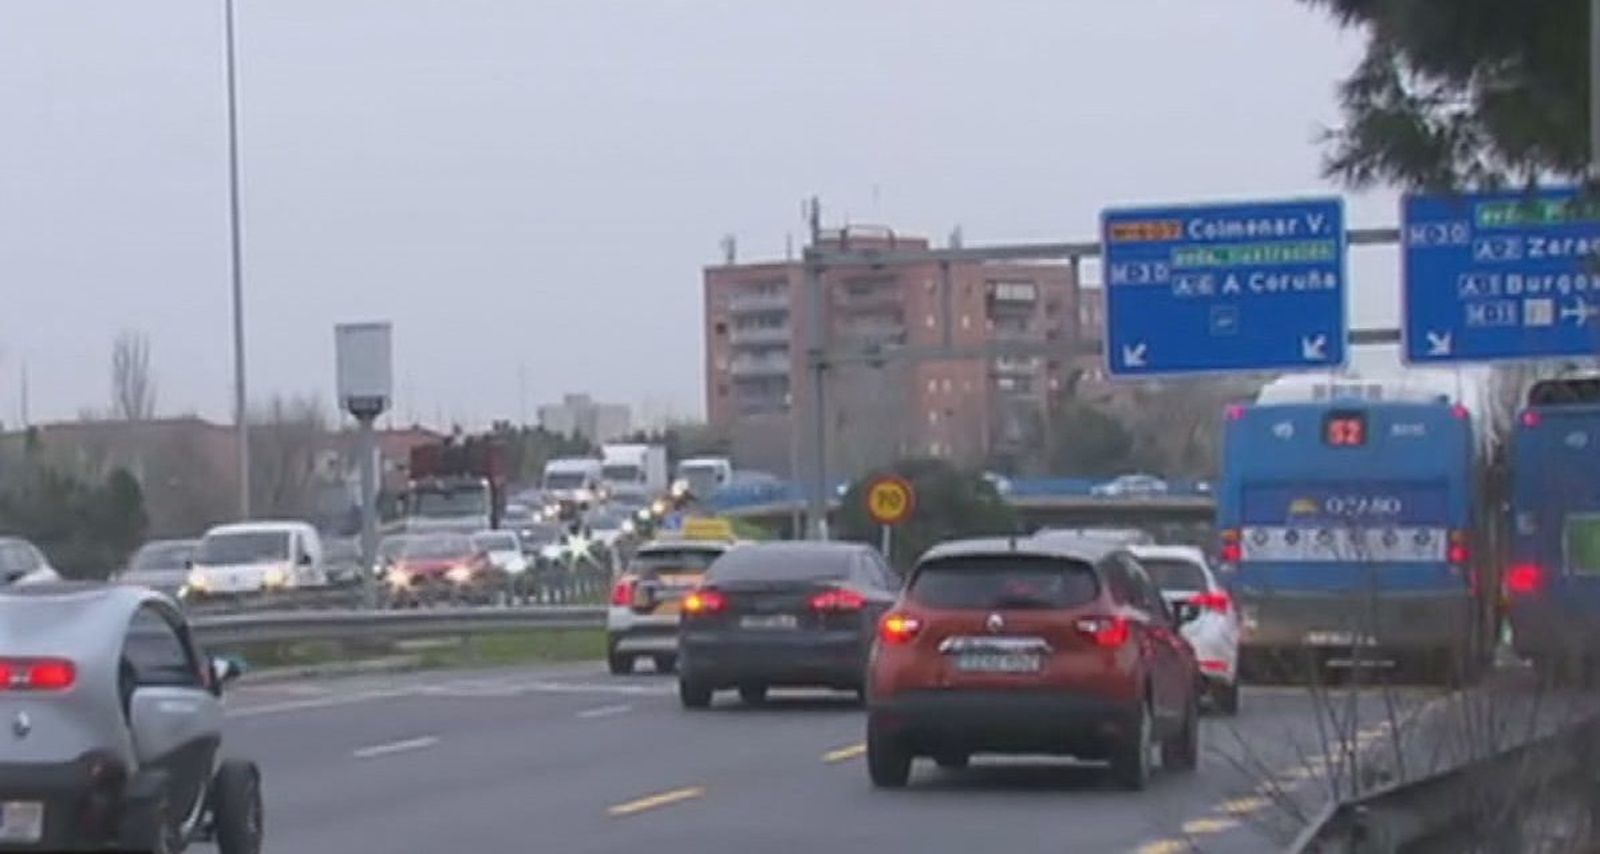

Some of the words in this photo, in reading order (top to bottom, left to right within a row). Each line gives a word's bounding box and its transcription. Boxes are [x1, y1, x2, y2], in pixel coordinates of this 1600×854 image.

[1187, 217, 1298, 239] Colmenar
[1306, 213, 1332, 234] V.
[1222, 274, 1241, 294] A
[1249, 270, 1337, 292] Coruña
